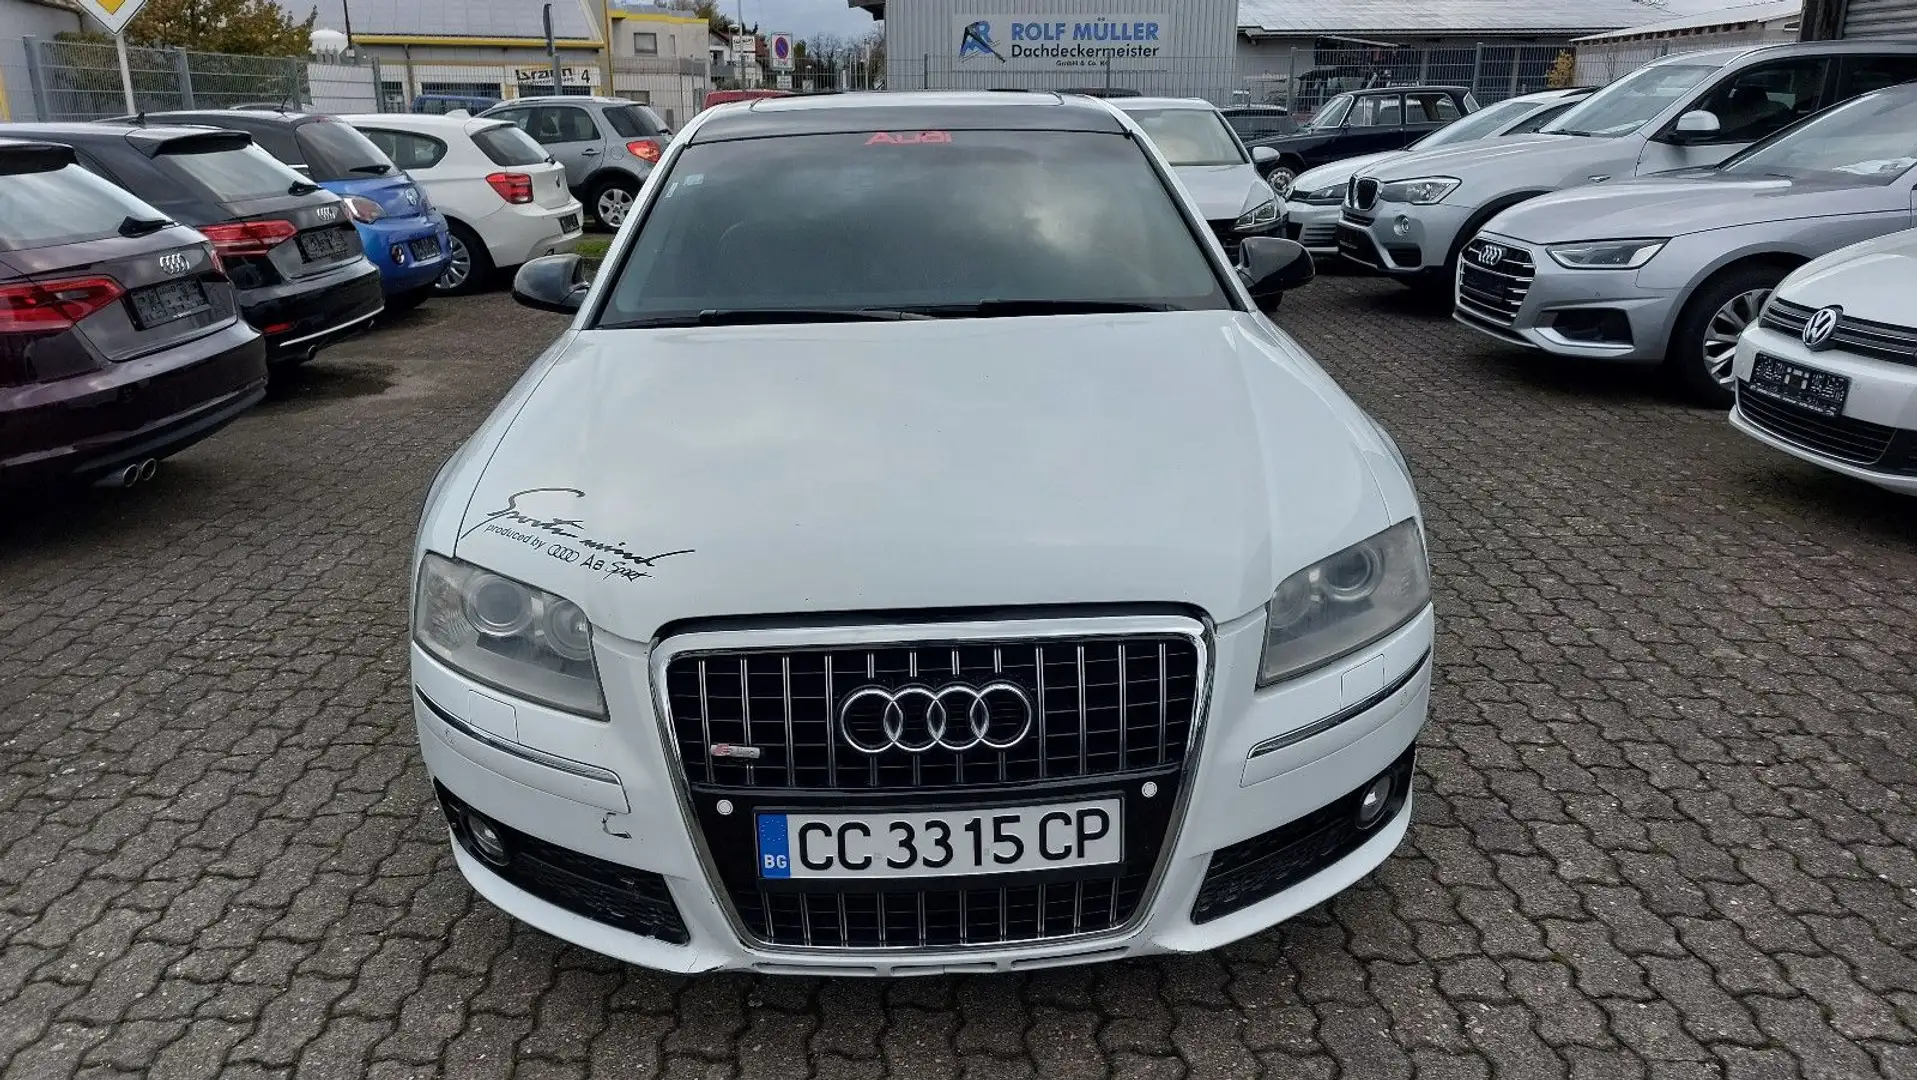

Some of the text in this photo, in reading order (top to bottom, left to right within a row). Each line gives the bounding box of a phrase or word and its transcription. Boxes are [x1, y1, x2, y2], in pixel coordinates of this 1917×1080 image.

[1011, 17, 1160, 41] ROLF MÜLLER
[1011, 43, 1160, 58] Dachdeckermeister
[581, 69, 591, 84] 4
[484, 523, 534, 545] produced
[531, 535, 547, 551] by
[580, 554, 604, 572] A8
[798, 807, 1111, 871] CC 3315 CP
[763, 853, 788, 869] BG
